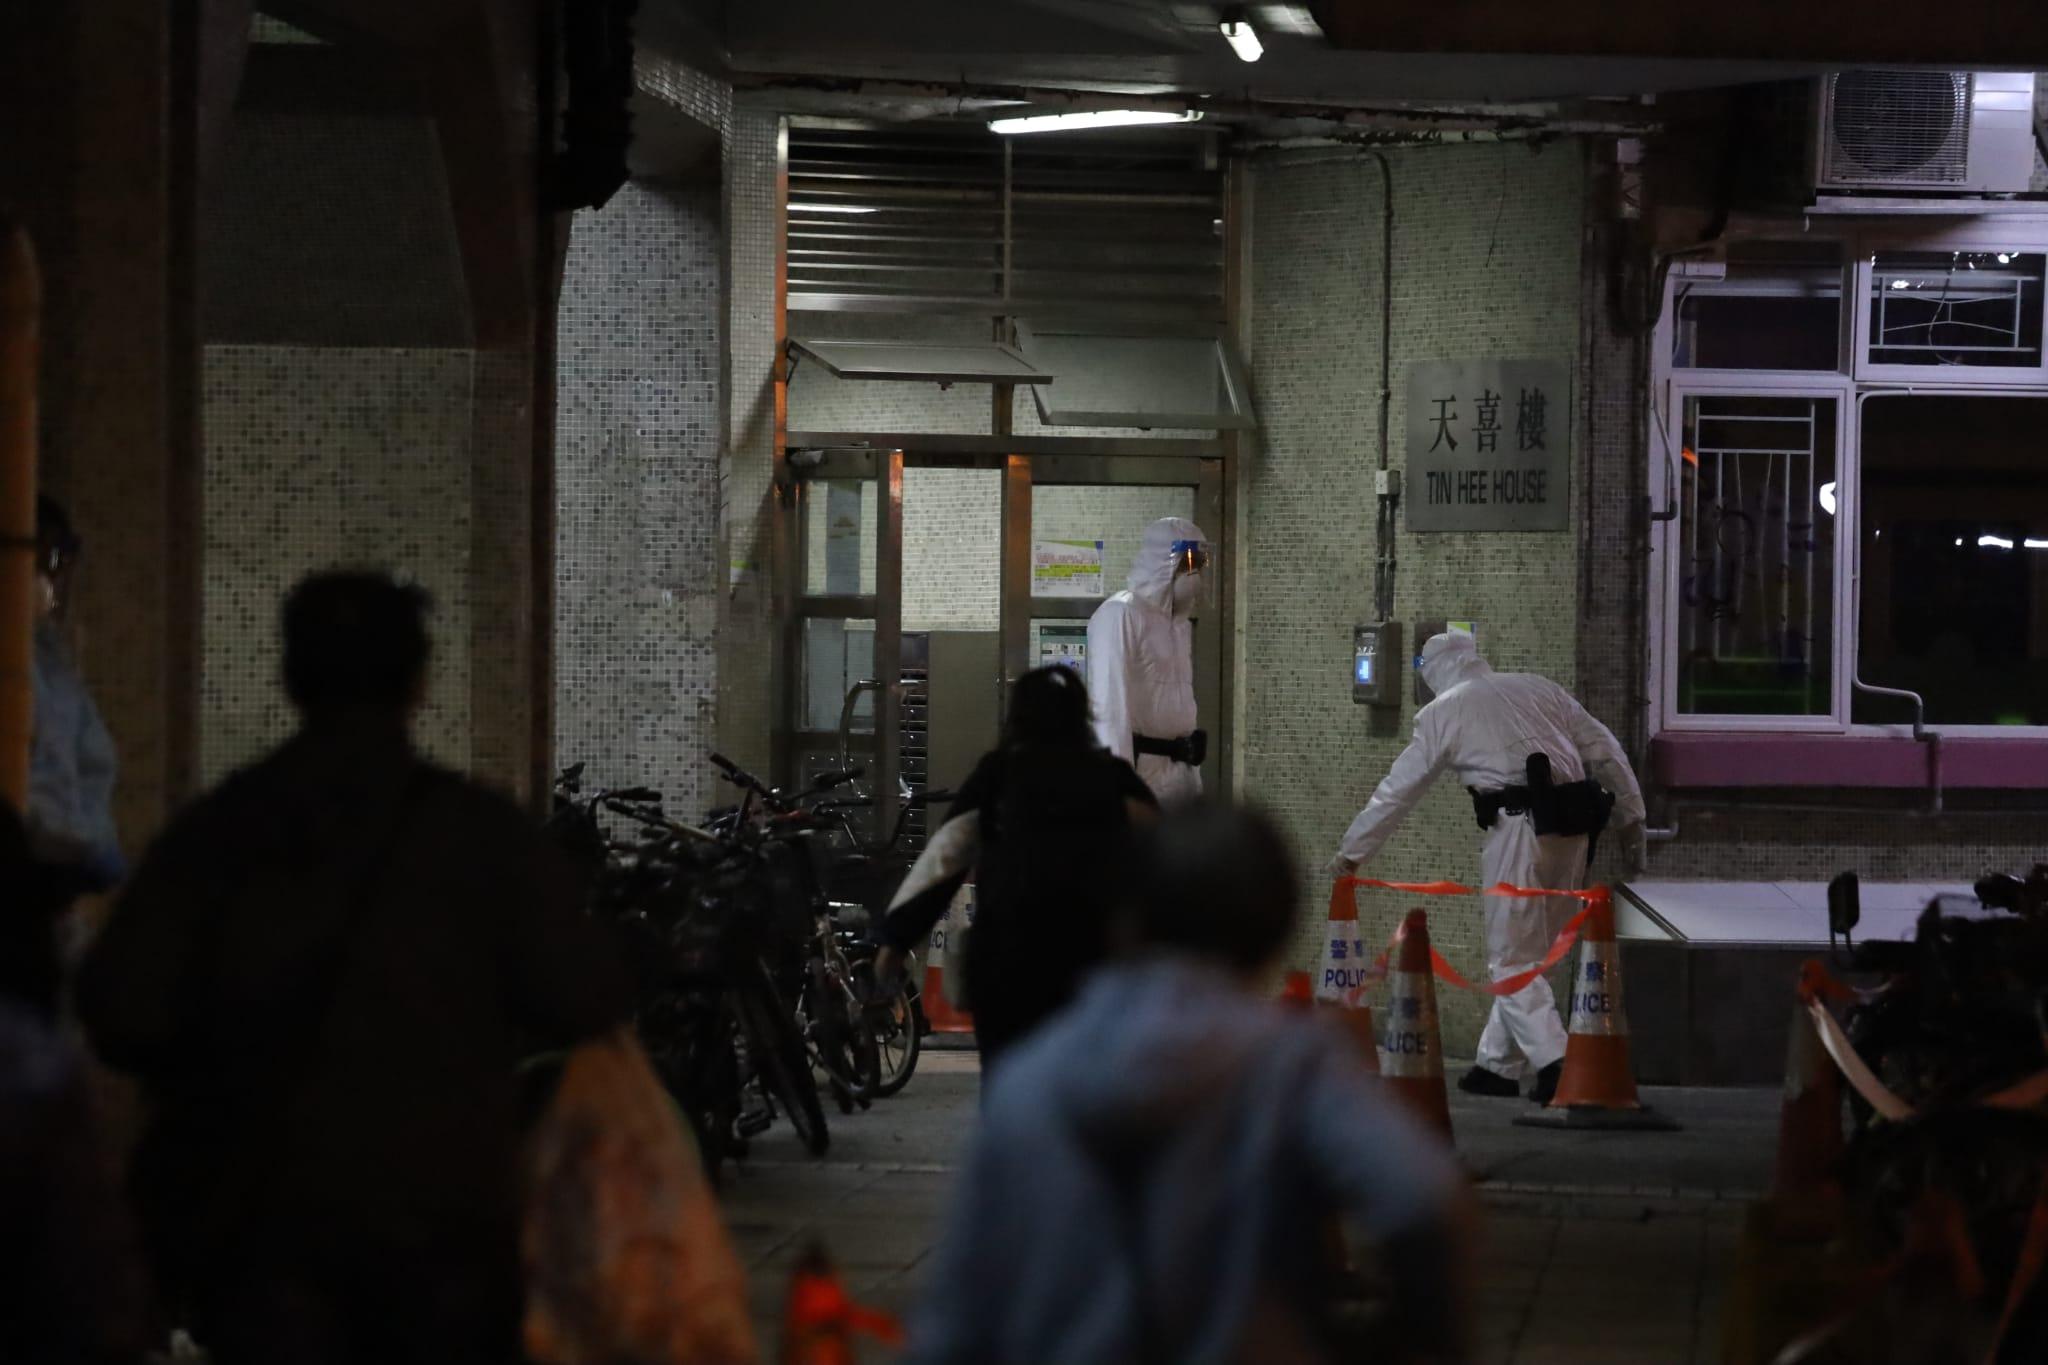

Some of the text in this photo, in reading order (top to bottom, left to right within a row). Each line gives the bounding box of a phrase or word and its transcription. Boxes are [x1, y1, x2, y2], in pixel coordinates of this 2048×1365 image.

[1429, 387, 1548, 453] 天喜樓
[1427, 469, 1547, 504] TIN HEE HOUSE
